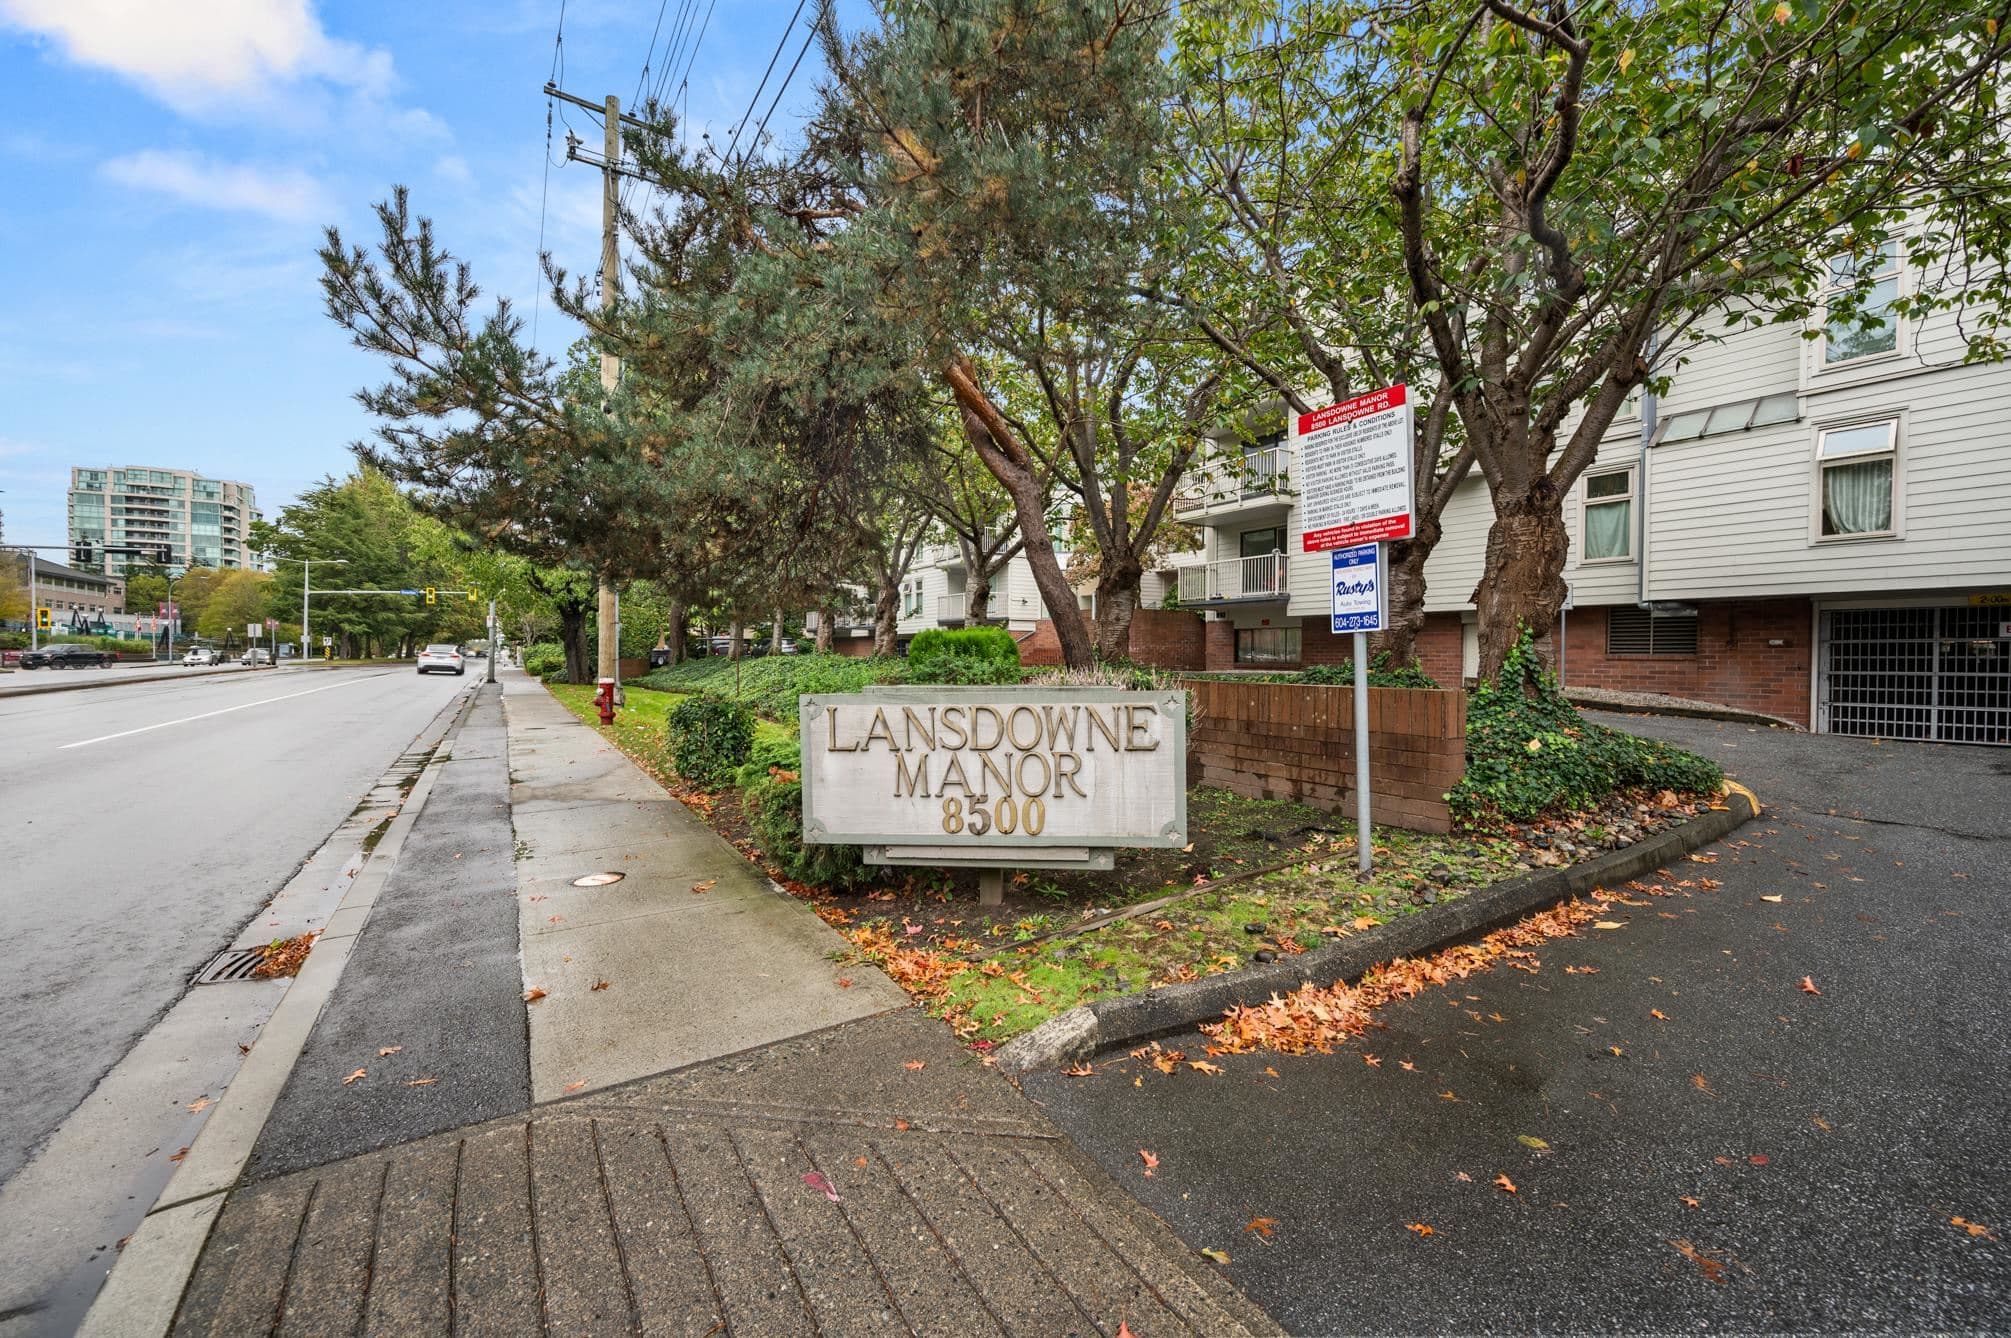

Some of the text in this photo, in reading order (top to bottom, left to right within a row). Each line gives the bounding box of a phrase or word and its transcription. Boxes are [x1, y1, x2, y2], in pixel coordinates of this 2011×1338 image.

[1313, 392, 1388, 421] LANSDOWNE MANOR
[1329, 406, 1374, 424] LANSDOWNE
[1377, 401, 1390, 410] RD.
[1308, 430, 1330, 441] PARKING
[1333, 424, 1350, 434] RULES
[1359, 412, 1395, 426] CONDITIONS
[1361, 522, 1381, 530] violation
[1336, 579, 1375, 596] Rusty's
[1335, 615, 1377, 629] 604-273-1645
[827, 704, 1161, 752] LANSDOWNE
[893, 751, 1087, 798] MANOR
[942, 796, 1046, 836] 8500
